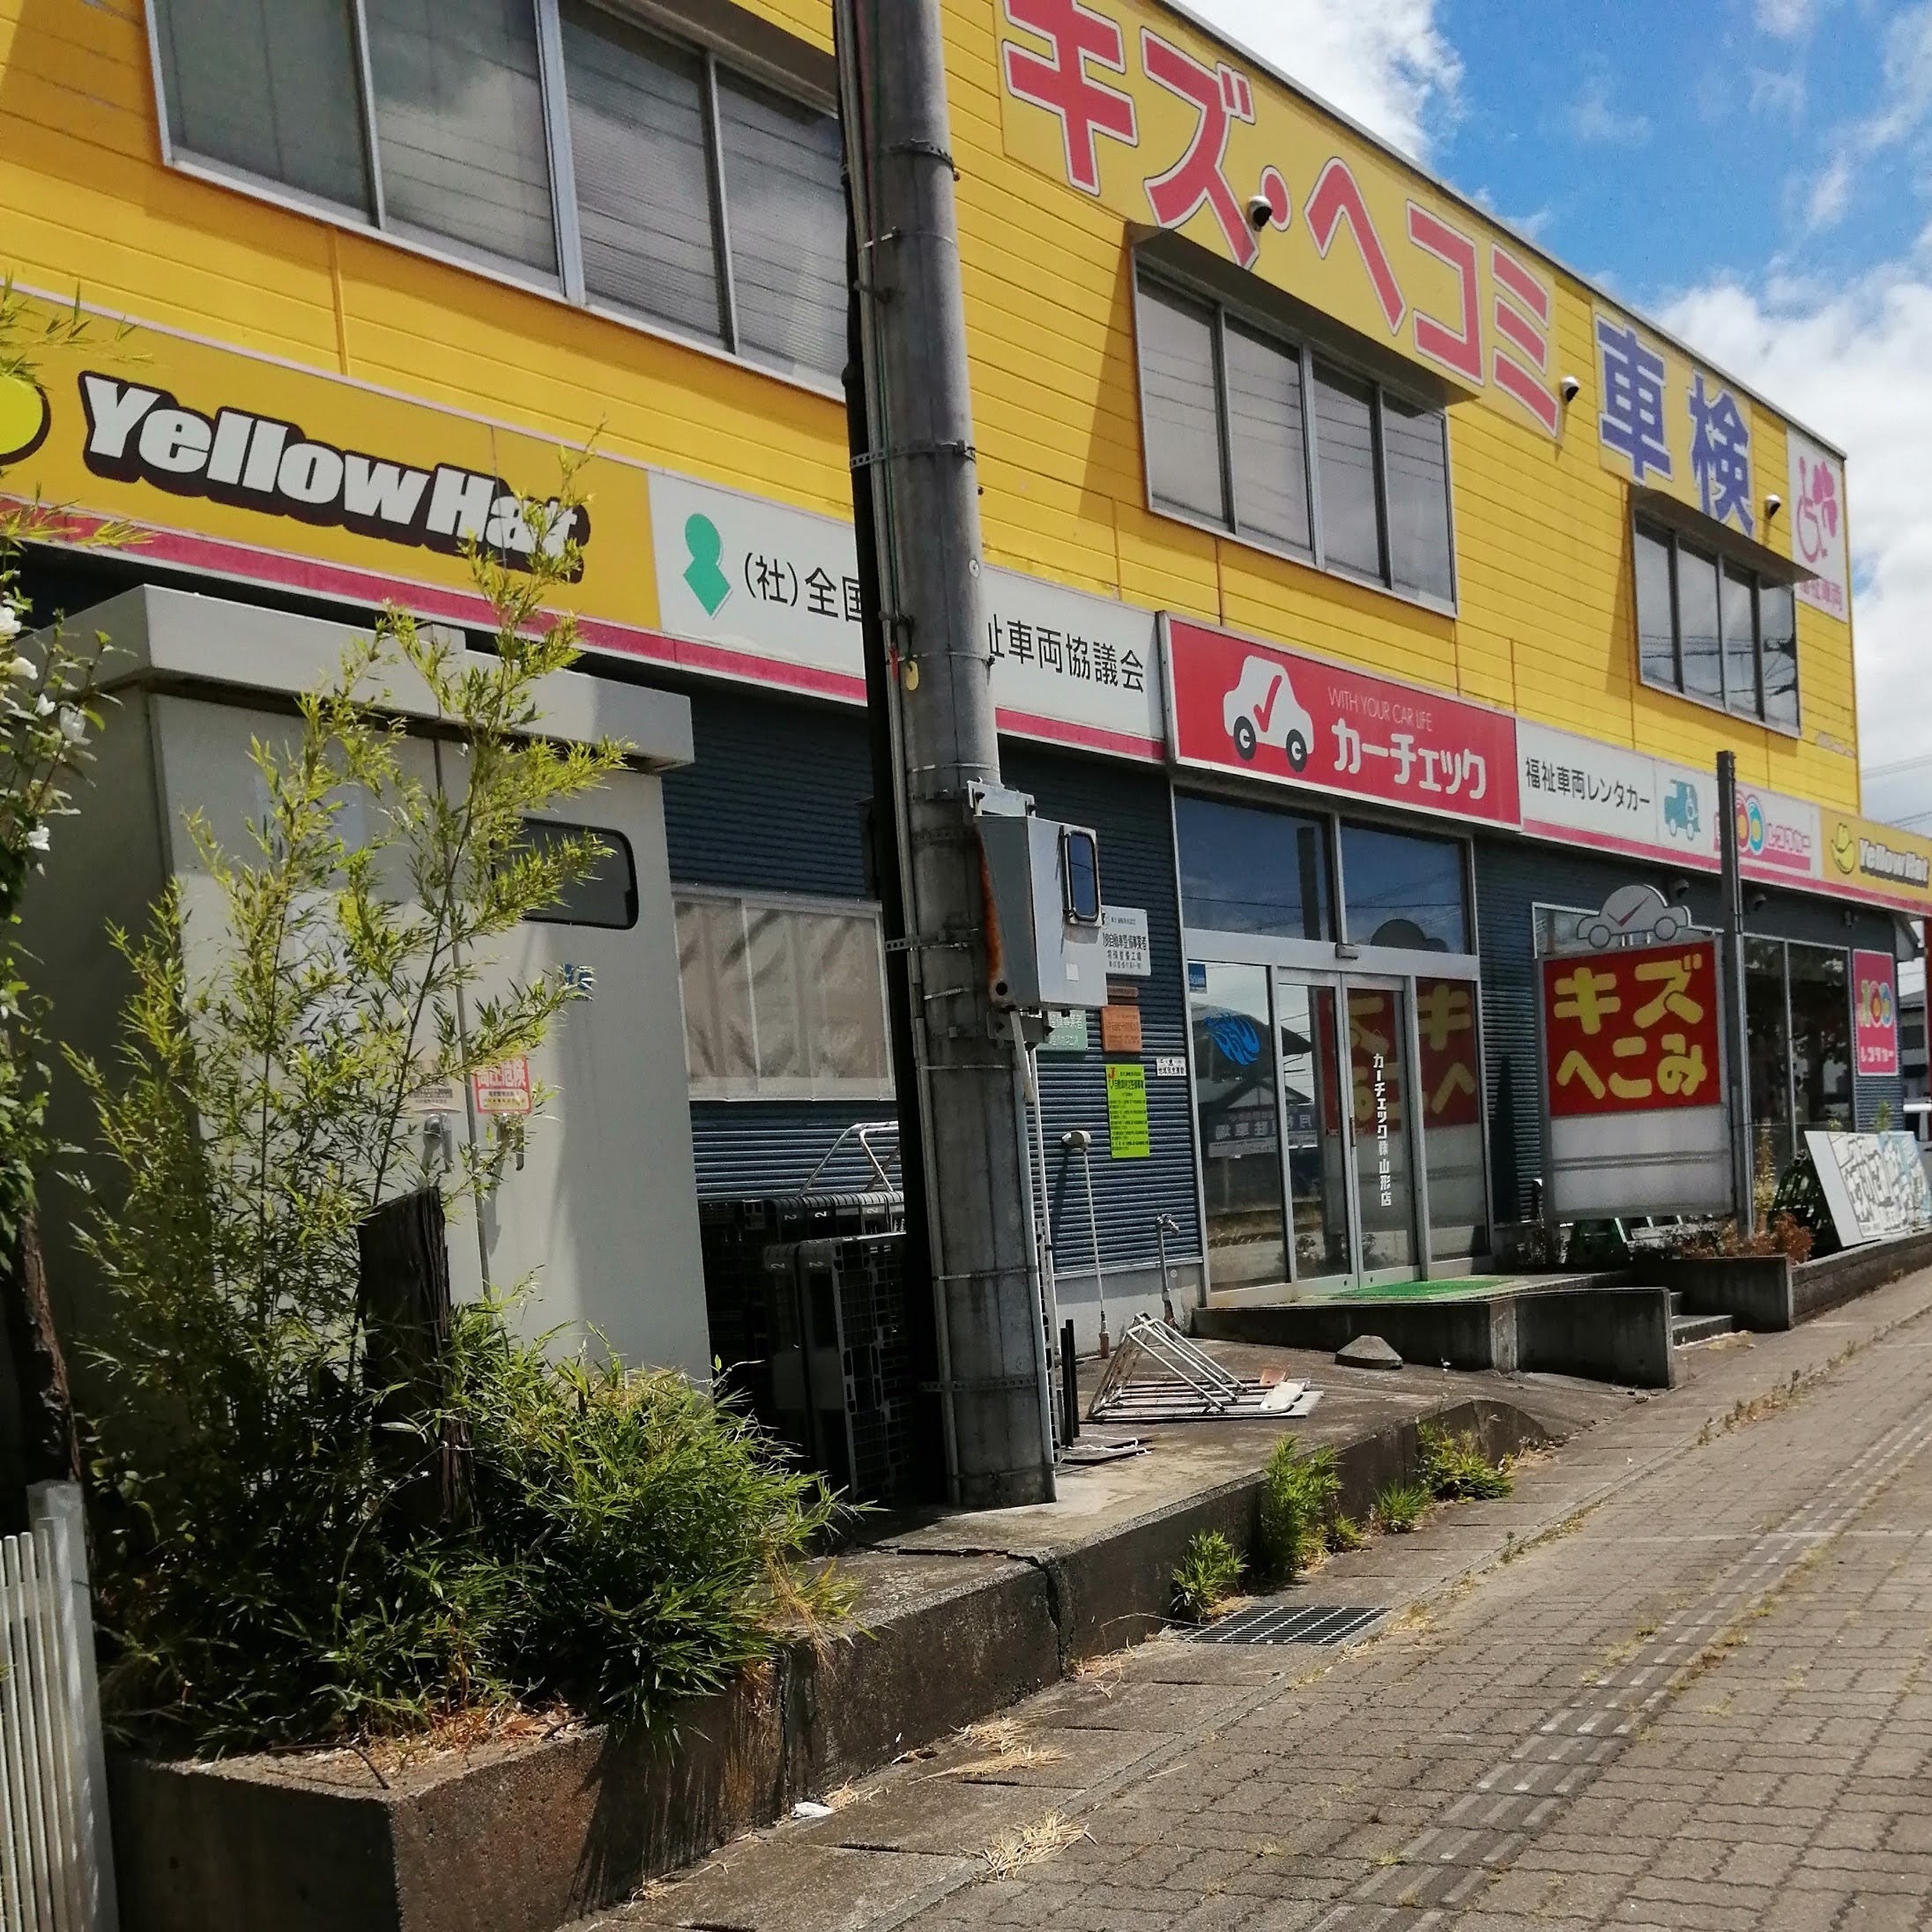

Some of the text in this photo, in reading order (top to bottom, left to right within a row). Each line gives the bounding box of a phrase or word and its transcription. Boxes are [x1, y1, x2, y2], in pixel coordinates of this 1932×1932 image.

[1595, 312, 1755, 538] 車検
[1328, 687, 1432, 732] WITH YOUR CAR LIFE
[1331, 717, 1486, 800] カーチェック
[1526, 756, 1651, 812] 福祉車両レンタカー
[1553, 954, 1704, 1036] キズ
[1556, 1033, 1707, 1100] へこみ
